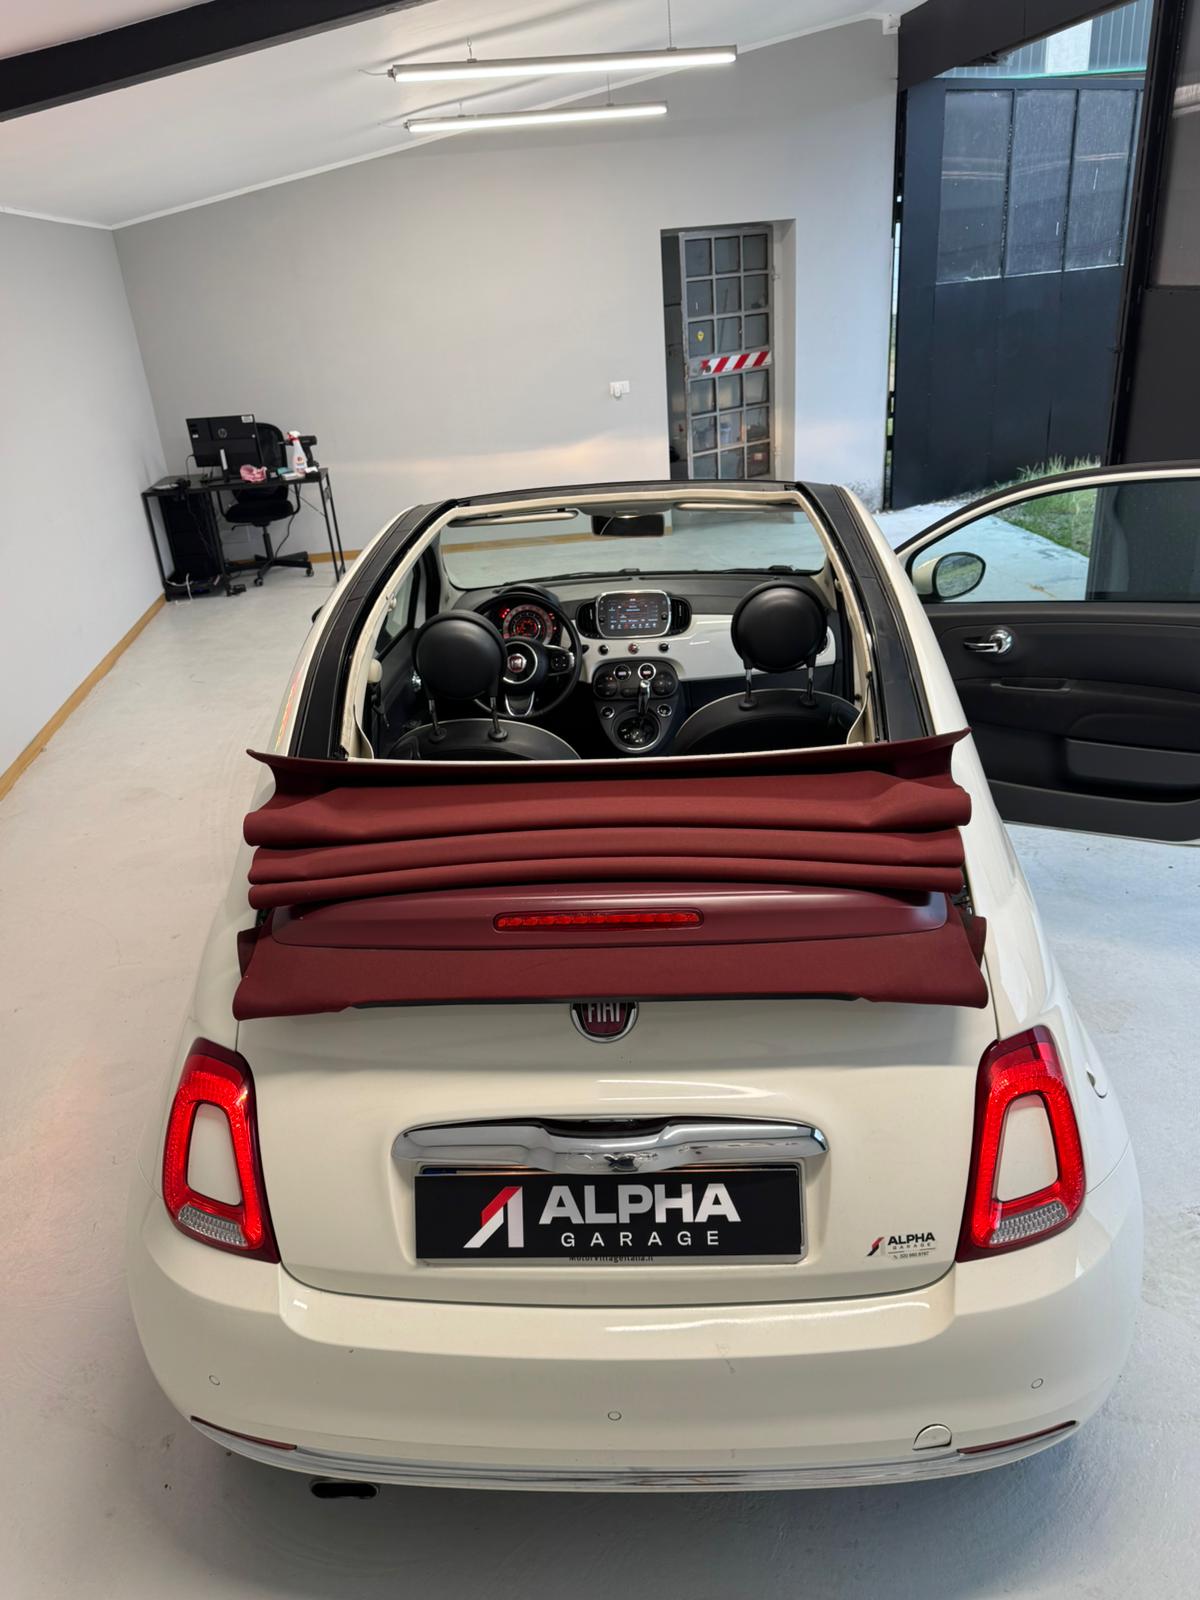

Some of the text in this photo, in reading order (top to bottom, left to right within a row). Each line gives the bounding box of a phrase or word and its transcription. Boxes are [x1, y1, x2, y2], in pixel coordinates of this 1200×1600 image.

[538, 1183, 742, 1225] ALPHA
[560, 1230, 720, 1248] GARAGE
[888, 1232, 935, 1245] ALPHA
